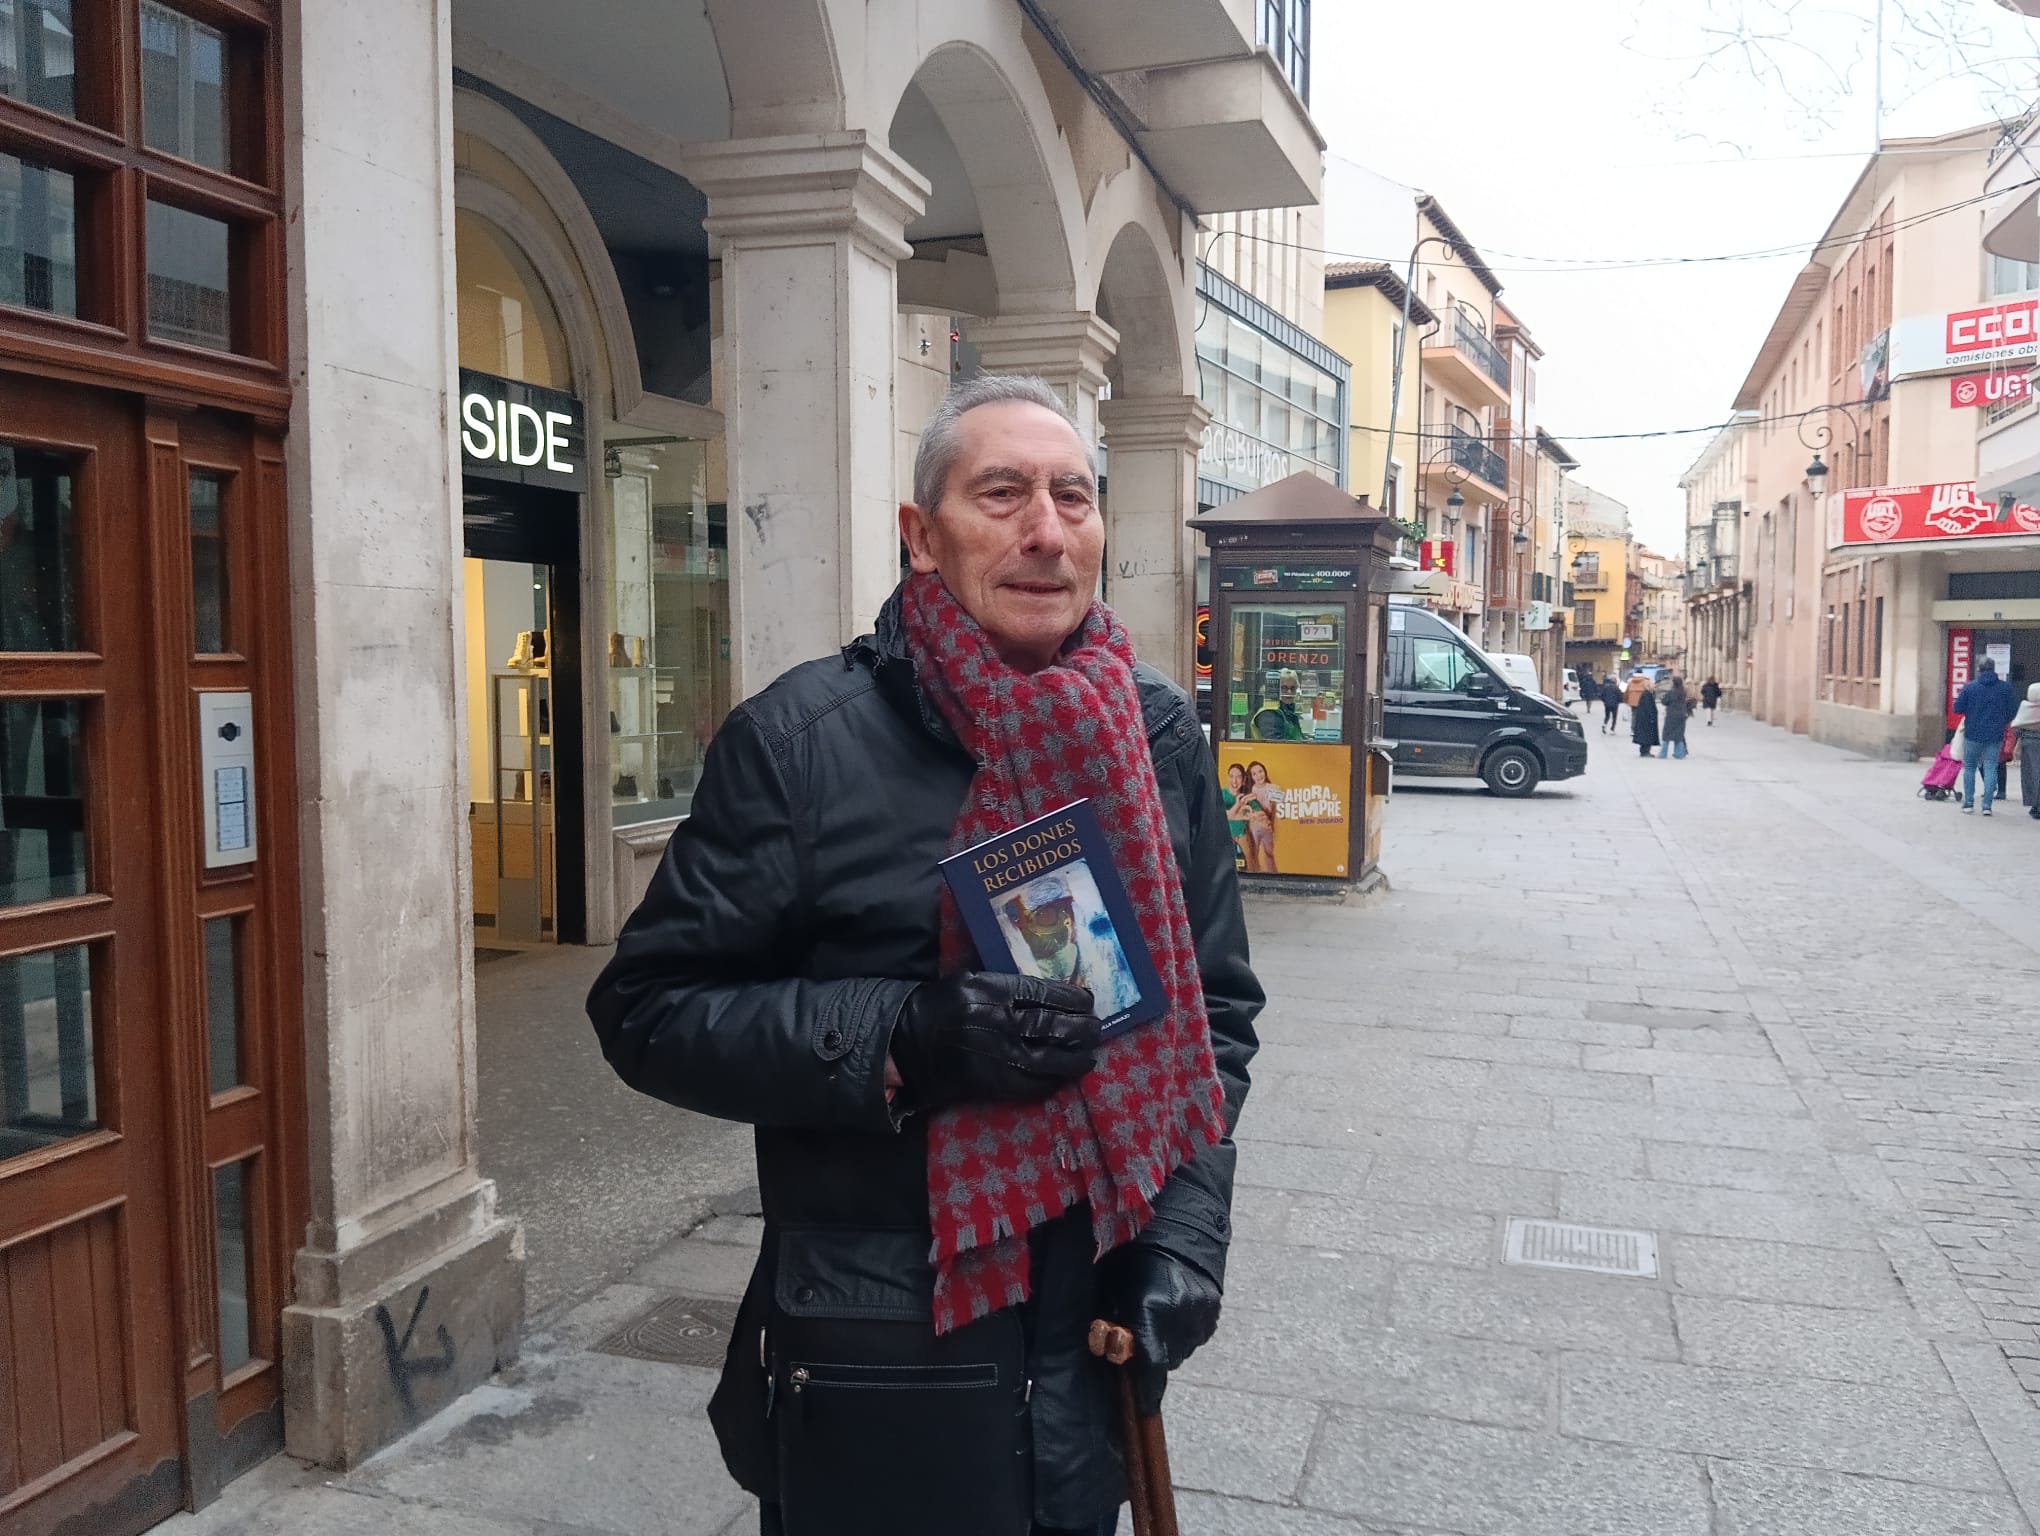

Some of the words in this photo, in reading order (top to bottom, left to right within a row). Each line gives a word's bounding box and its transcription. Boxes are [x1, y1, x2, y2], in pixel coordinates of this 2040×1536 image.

[1952, 308, 2039, 345] CCO
[1945, 348, 2014, 365] comisiones
[462, 392, 574, 474] SIDE
[1276, 800, 1342, 820] SIEMPRE
[1284, 785, 1331, 803] AHORA
[973, 848, 1009, 875] LOS
[1011, 818, 1076, 858] DONES
[983, 838, 1082, 893] RECIBIDOS
